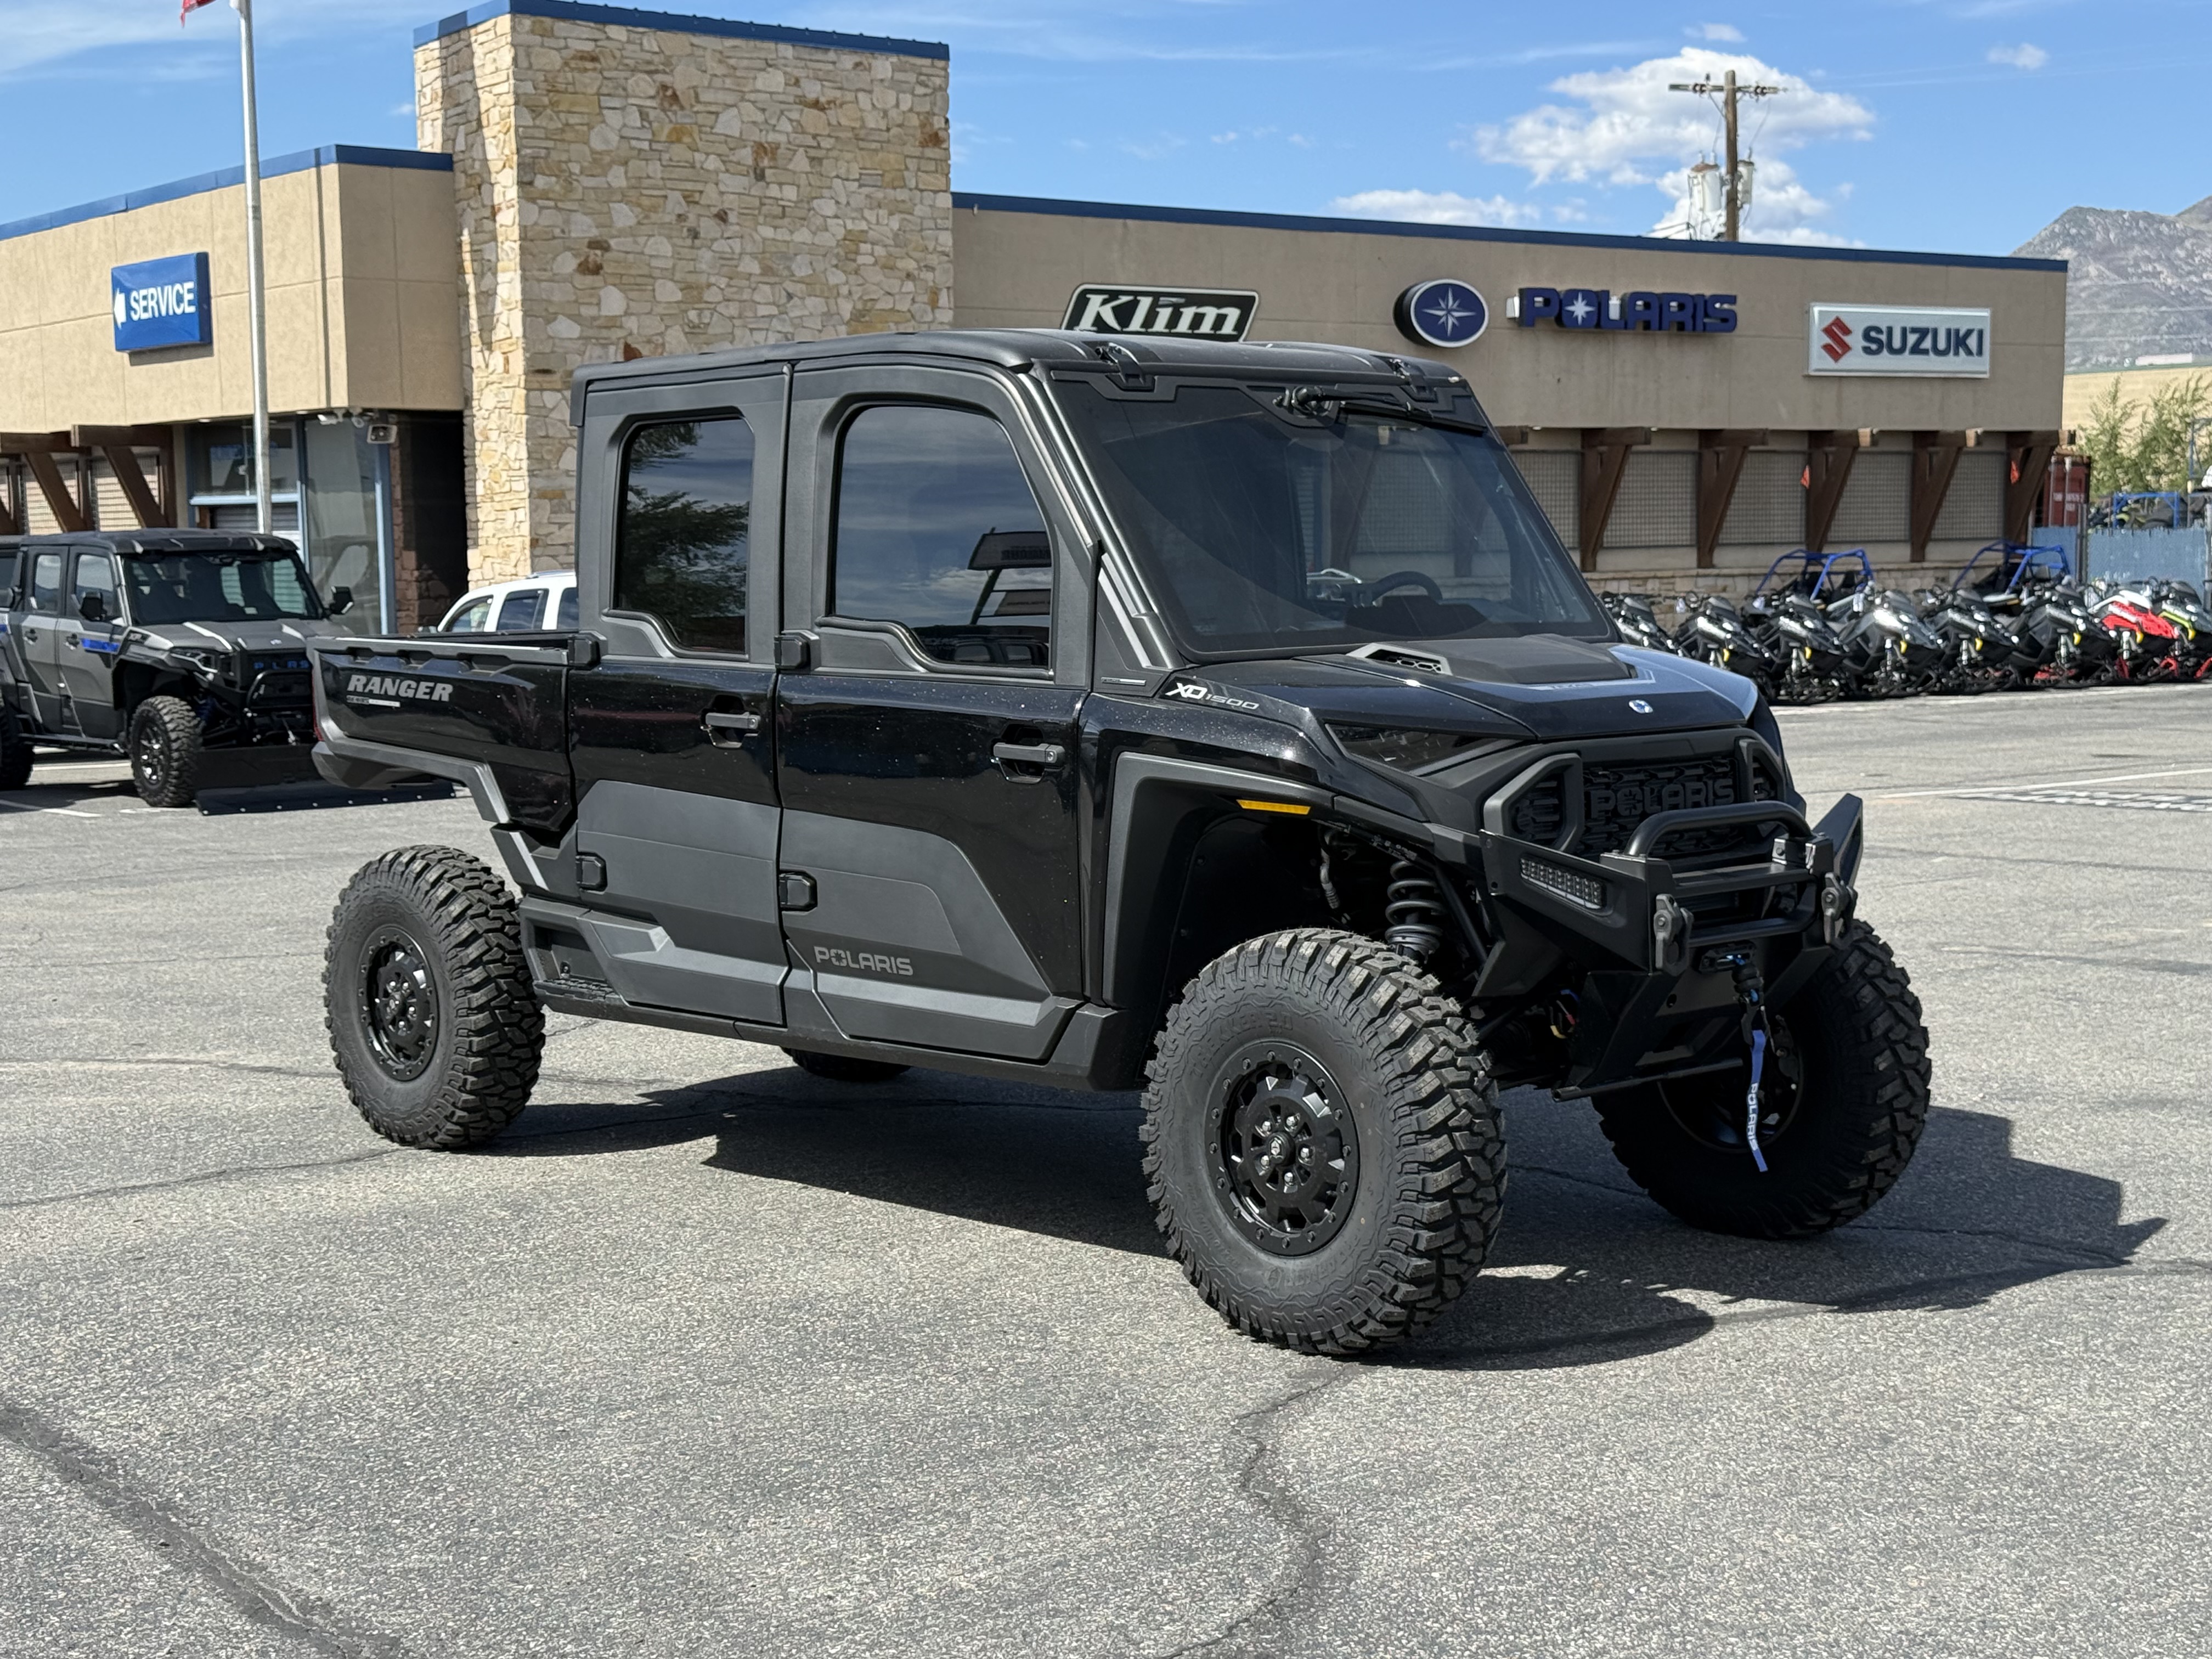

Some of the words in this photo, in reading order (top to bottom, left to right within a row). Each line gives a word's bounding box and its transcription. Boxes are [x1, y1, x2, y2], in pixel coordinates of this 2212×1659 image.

[130, 281, 196, 321] SERVICE
[1074, 294, 1240, 335] Klim
[1519, 287, 1737, 333] POLARIS
[1861, 325, 1984, 357] SUZUKI
[347, 675, 454, 702] RANGER
[1165, 682, 1207, 699] XD
[1205, 693, 1260, 710] 1500
[1590, 778, 1735, 819] POLARIS
[814, 946, 913, 976] POLARIS
[1747, 1082, 1759, 1151] POLARIS
